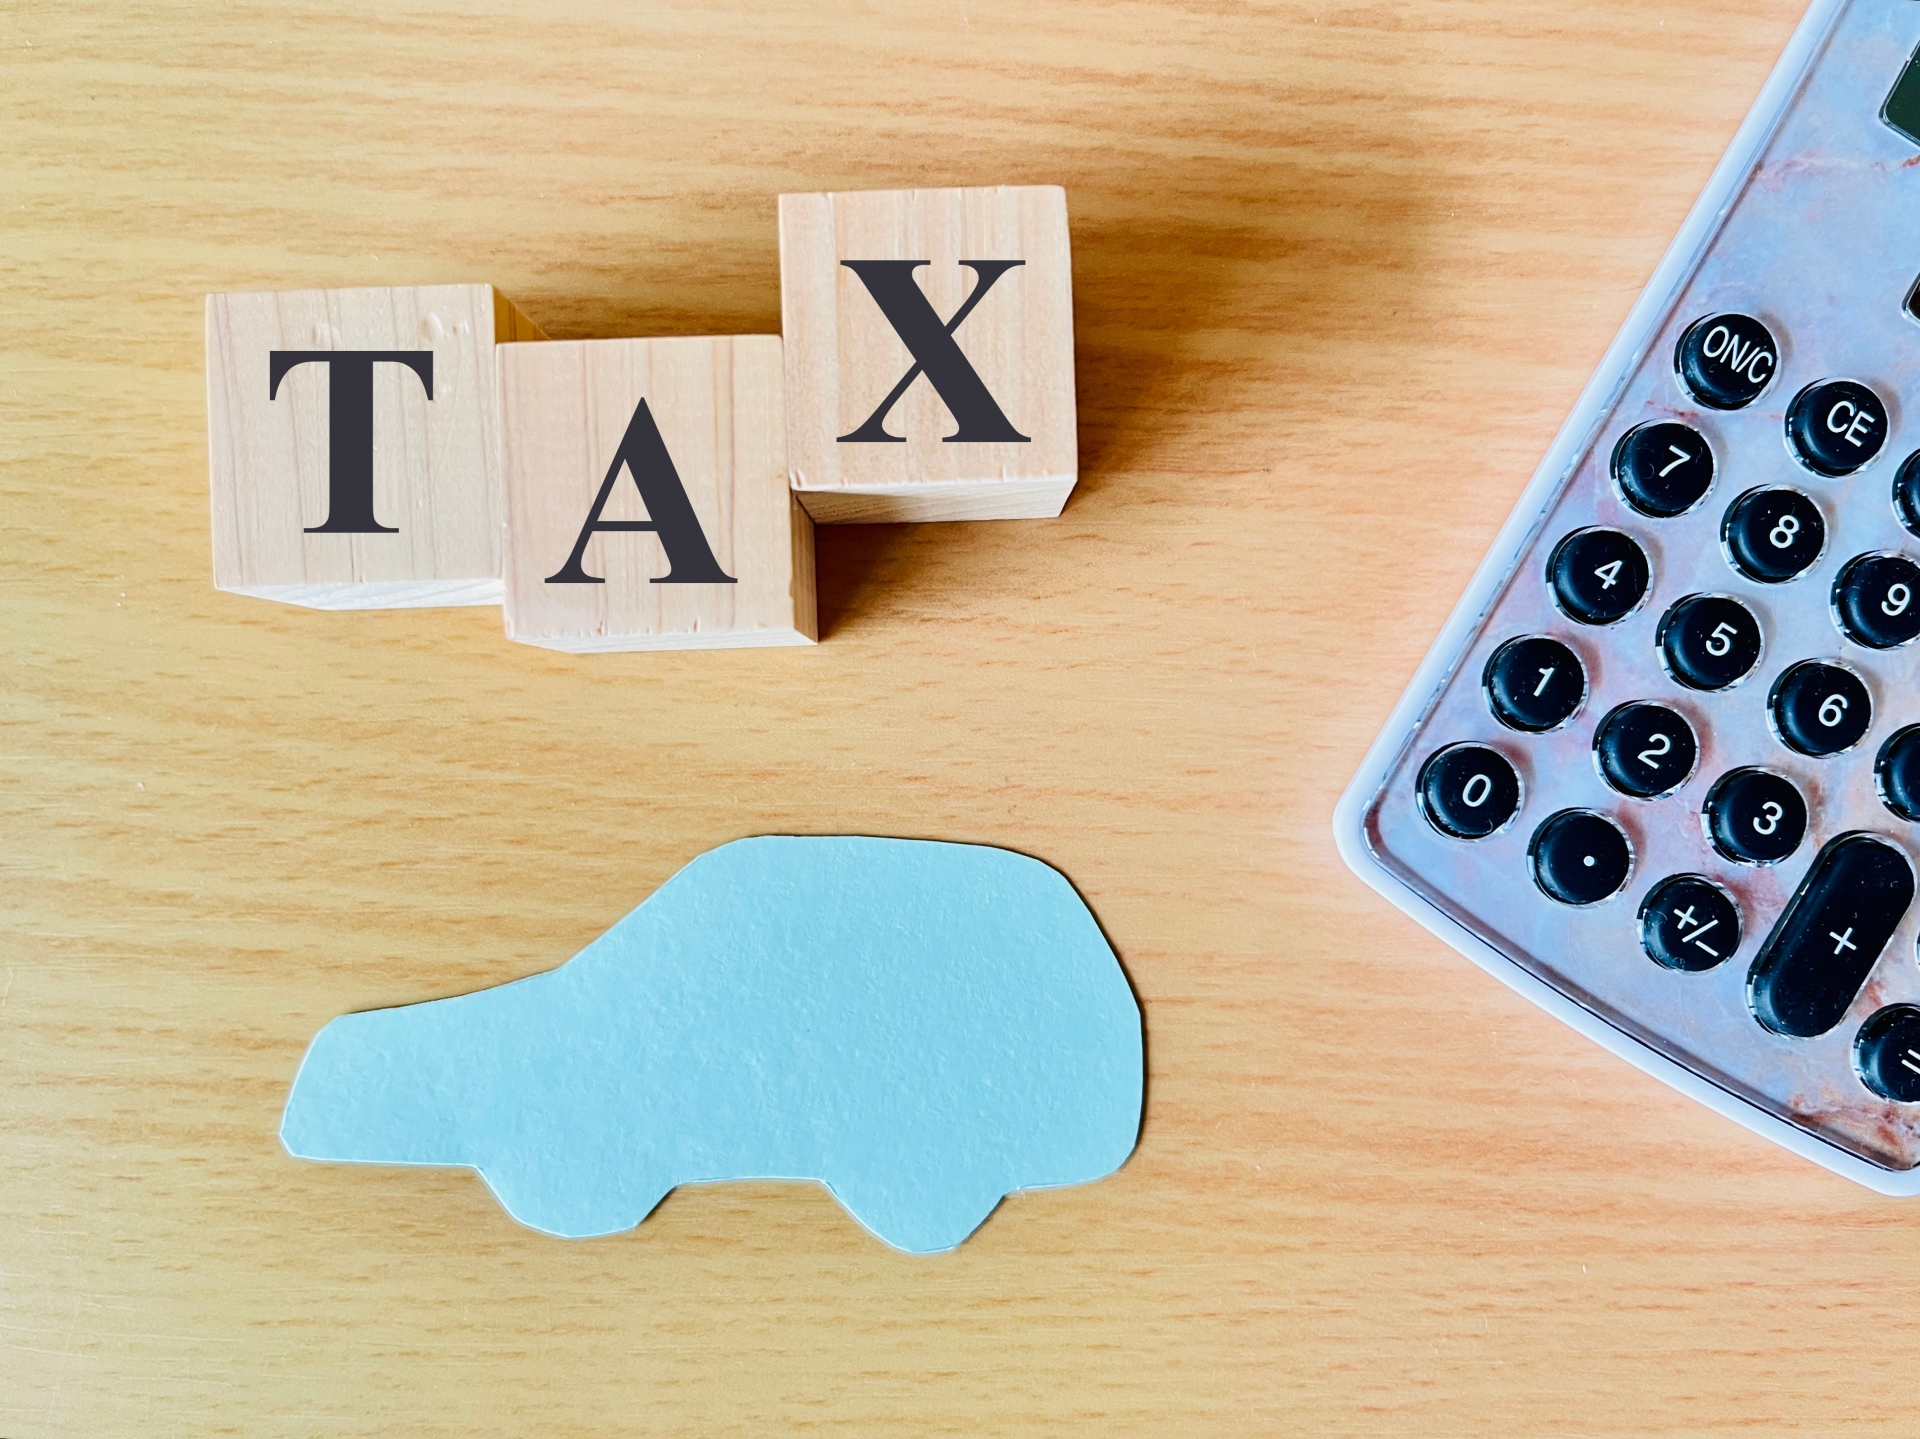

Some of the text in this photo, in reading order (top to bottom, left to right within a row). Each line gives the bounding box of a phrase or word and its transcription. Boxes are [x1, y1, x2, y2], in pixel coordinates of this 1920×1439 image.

[1703, 325, 1773, 384] ON/C
[269, 260, 1032, 584] TAX
[1827, 401, 1874, 447] CE
[1659, 445, 1690, 477] 7
[1770, 515, 1799, 548] 8
[1594, 561, 1622, 589] 4
[1882, 584, 1910, 616] 9
[1706, 622, 1737, 656] 5
[1534, 668, 1554, 696] 1
[1819, 694, 1847, 726] 6
[1638, 734, 1670, 769] 2
[1463, 774, 1491, 807] 0
[1753, 802, 1782, 834] 3
